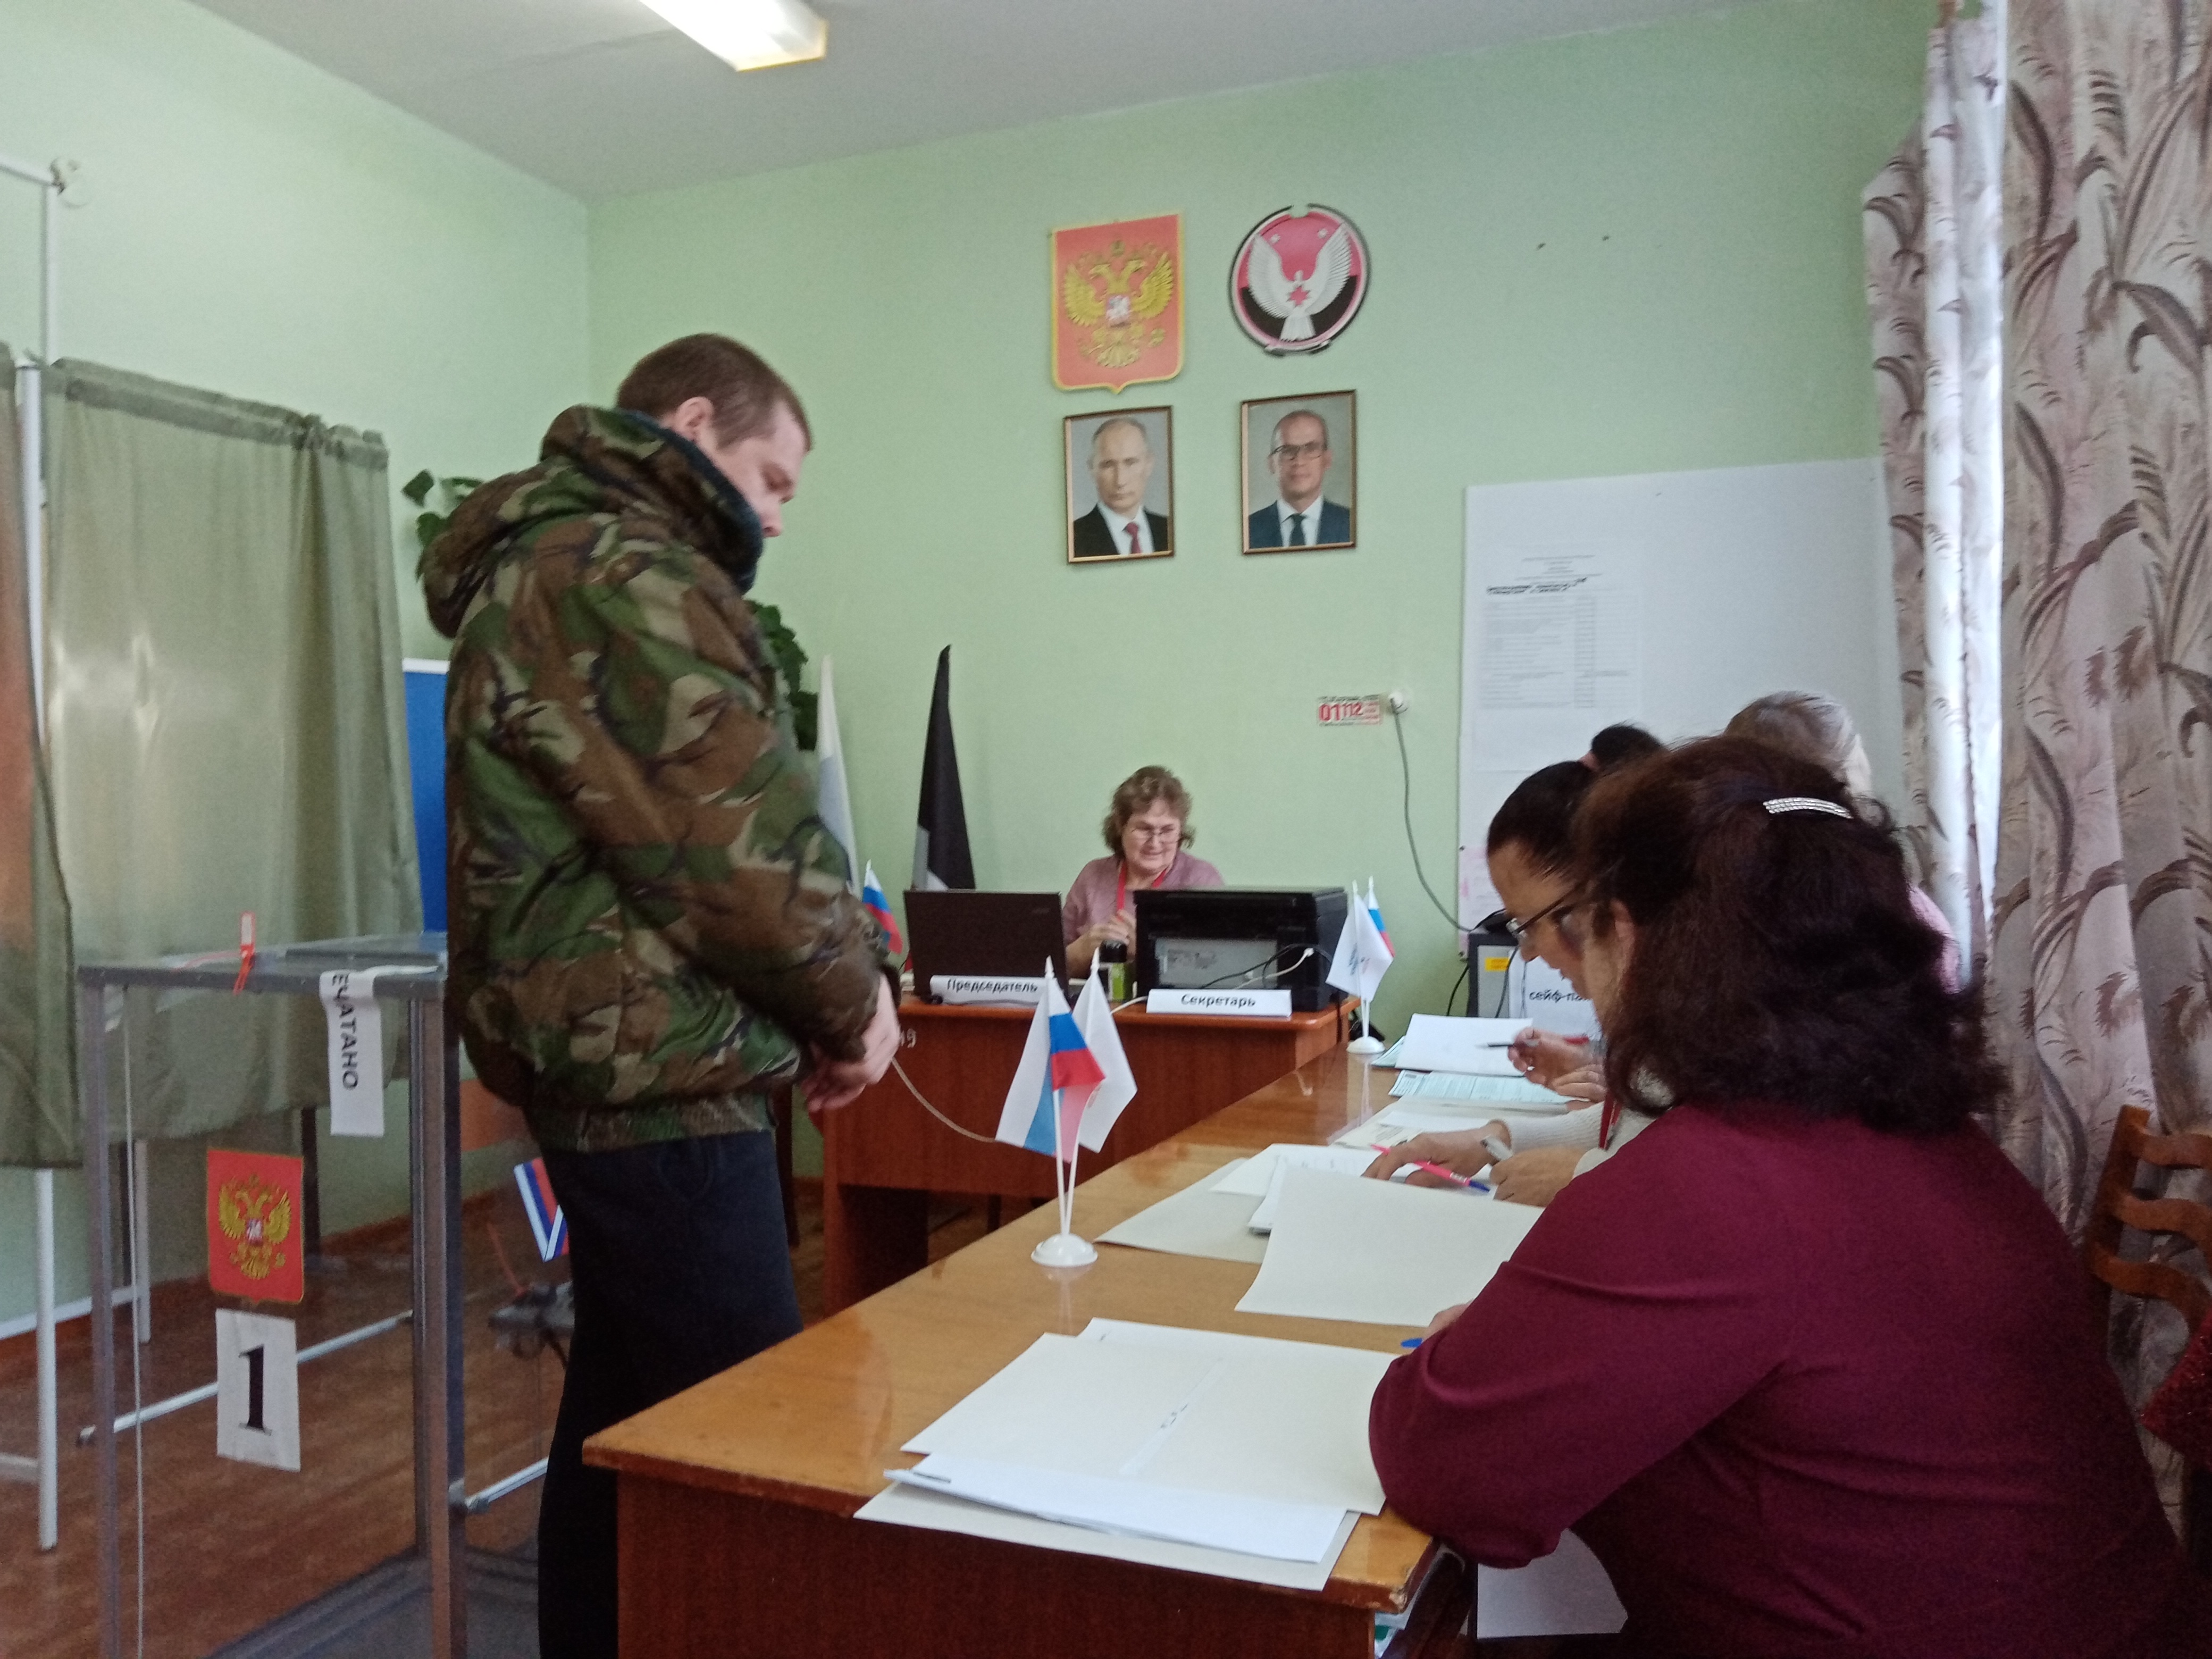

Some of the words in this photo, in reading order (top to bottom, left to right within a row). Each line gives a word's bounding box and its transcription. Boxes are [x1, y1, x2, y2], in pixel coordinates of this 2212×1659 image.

[946, 977, 1038, 994] Председатель
[1180, 993, 1256, 1009] Секретарь
[238, 1344, 272, 1436] 1
